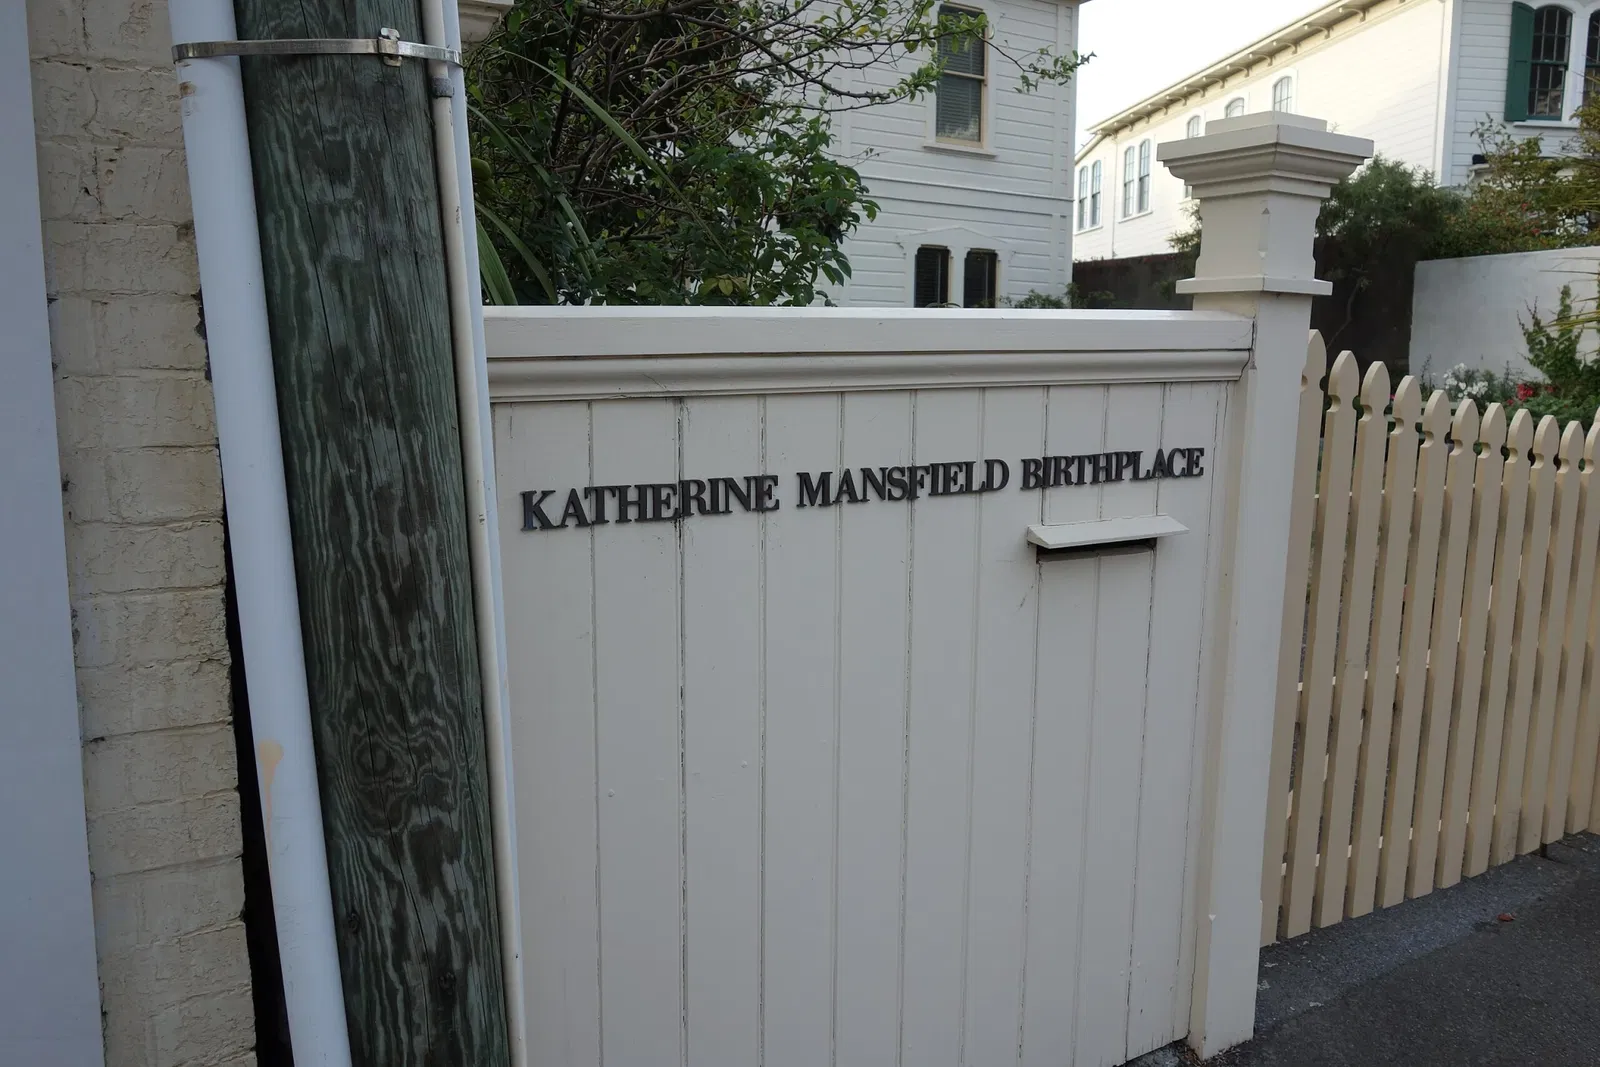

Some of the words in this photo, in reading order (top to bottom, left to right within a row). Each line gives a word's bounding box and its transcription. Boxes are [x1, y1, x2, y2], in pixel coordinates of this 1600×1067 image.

[521, 474, 779, 531] KATHERINE
[796, 459, 1009, 508] MANSFIELD
[1020, 447, 1205, 491] BIRTHPLACE
